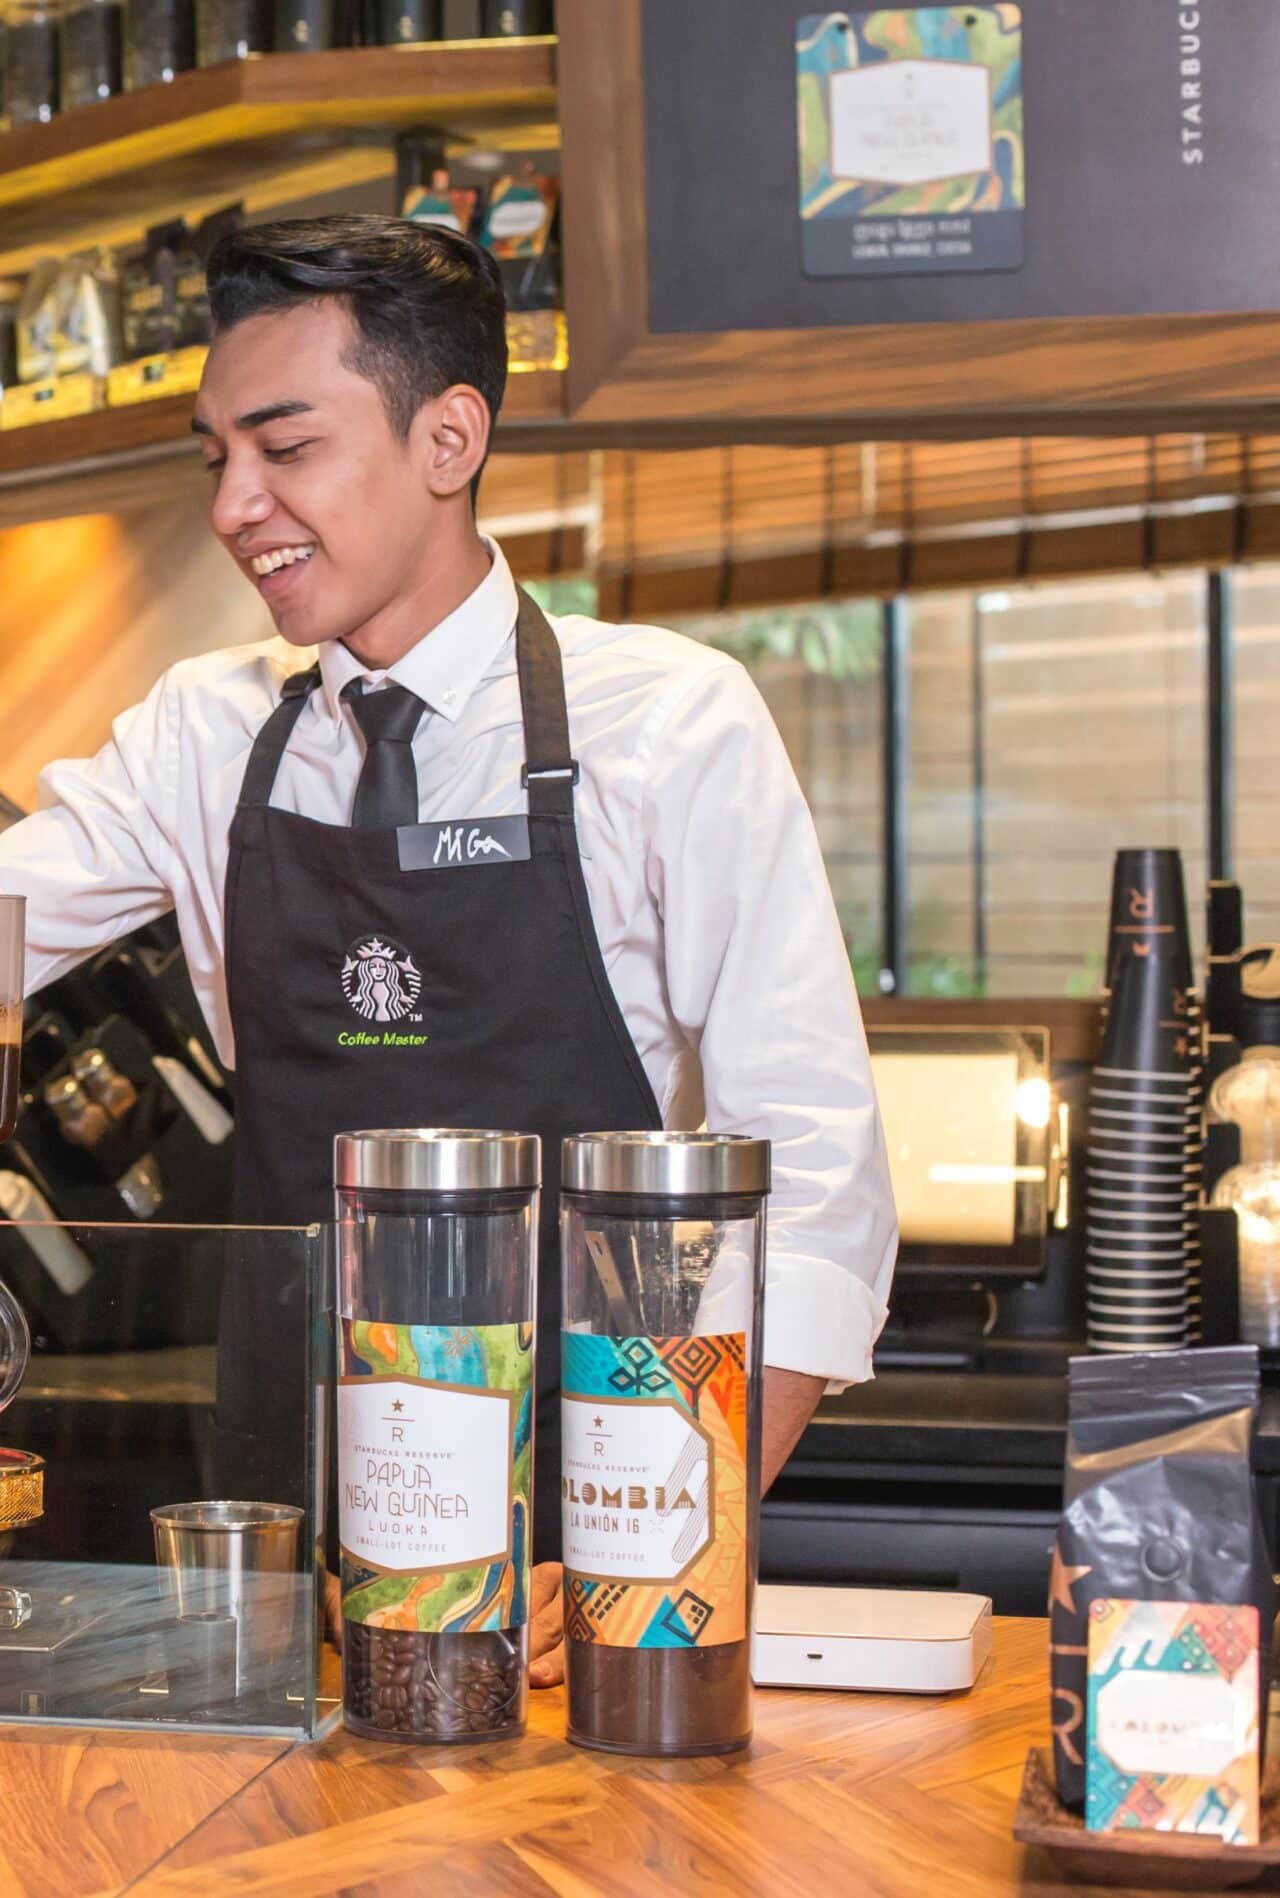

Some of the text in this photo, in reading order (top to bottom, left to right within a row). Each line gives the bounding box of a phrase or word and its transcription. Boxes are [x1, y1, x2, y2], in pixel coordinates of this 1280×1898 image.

[1179, 0, 1203, 165] STARBUC
[338, 1032, 428, 1045] Coffee Master
[392, 1427, 404, 1442] R
[594, 1442, 604, 1456] R
[366, 1460, 432, 1490] PAPUA
[345, 1483, 469, 1519] NEW GUINEA
[570, 1512, 640, 1534] LA UNIÓN 16
